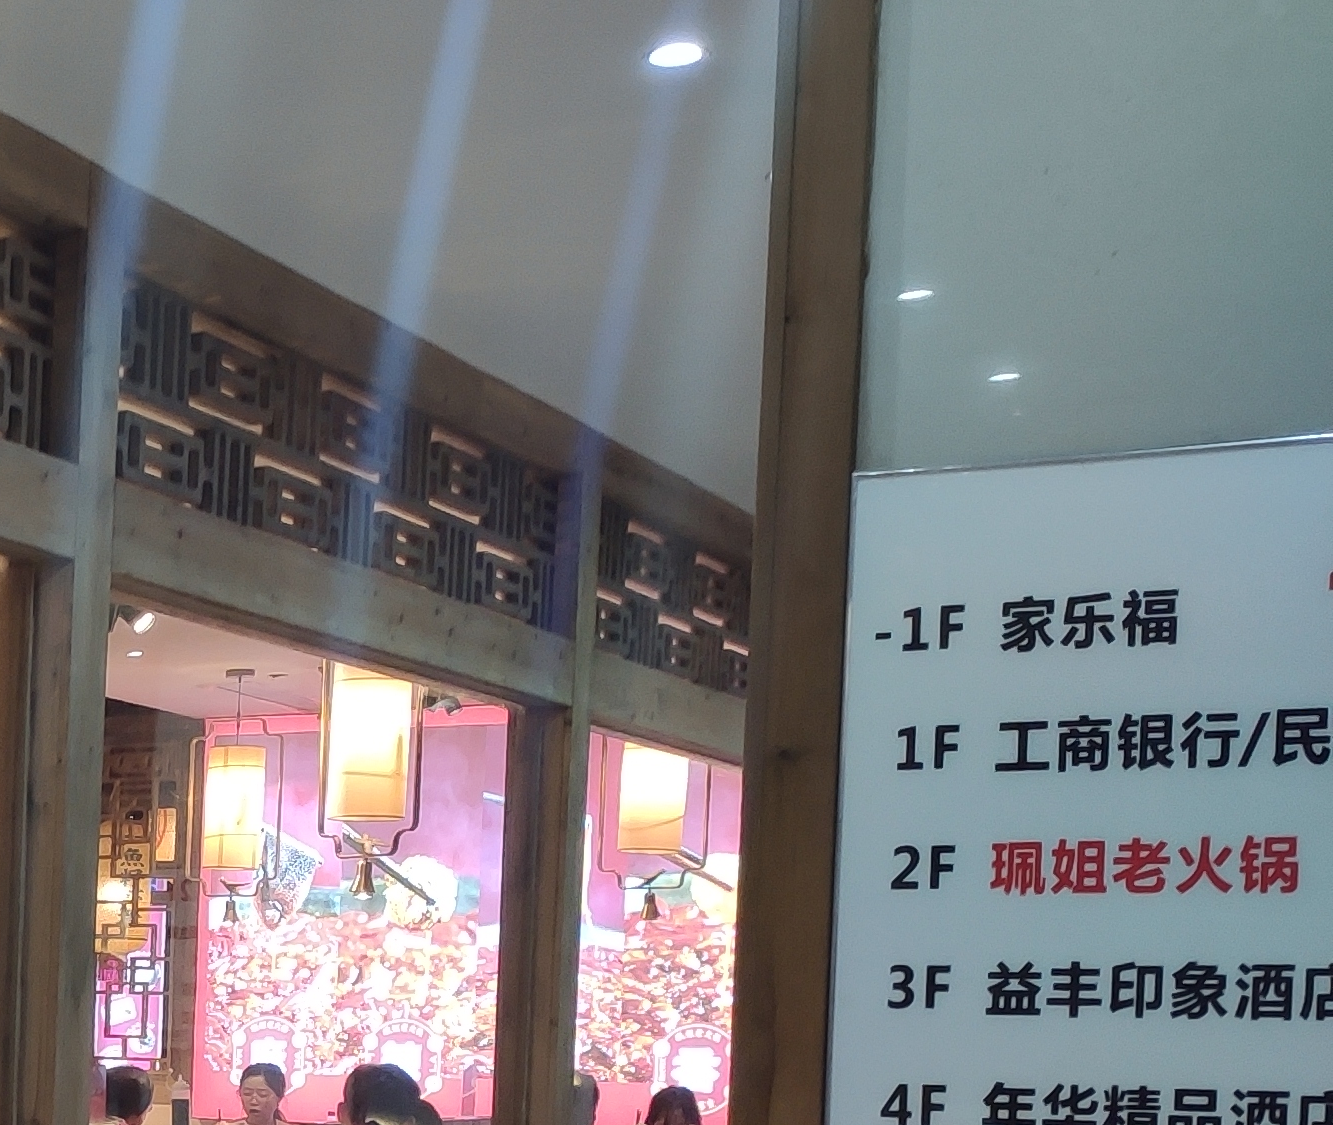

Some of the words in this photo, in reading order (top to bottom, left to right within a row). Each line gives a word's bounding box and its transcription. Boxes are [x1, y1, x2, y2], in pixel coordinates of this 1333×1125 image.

[875, 604, 966, 652] -1F
[1001, 588, 1180, 653] 家乐福
[896, 724, 961, 771] 1F
[994, 707, 1332, 773] 工商银行/民
[890, 844, 956, 890] 2F
[990, 835, 1299, 896] 珮姐老火锅
[887, 964, 952, 1010] 3F
